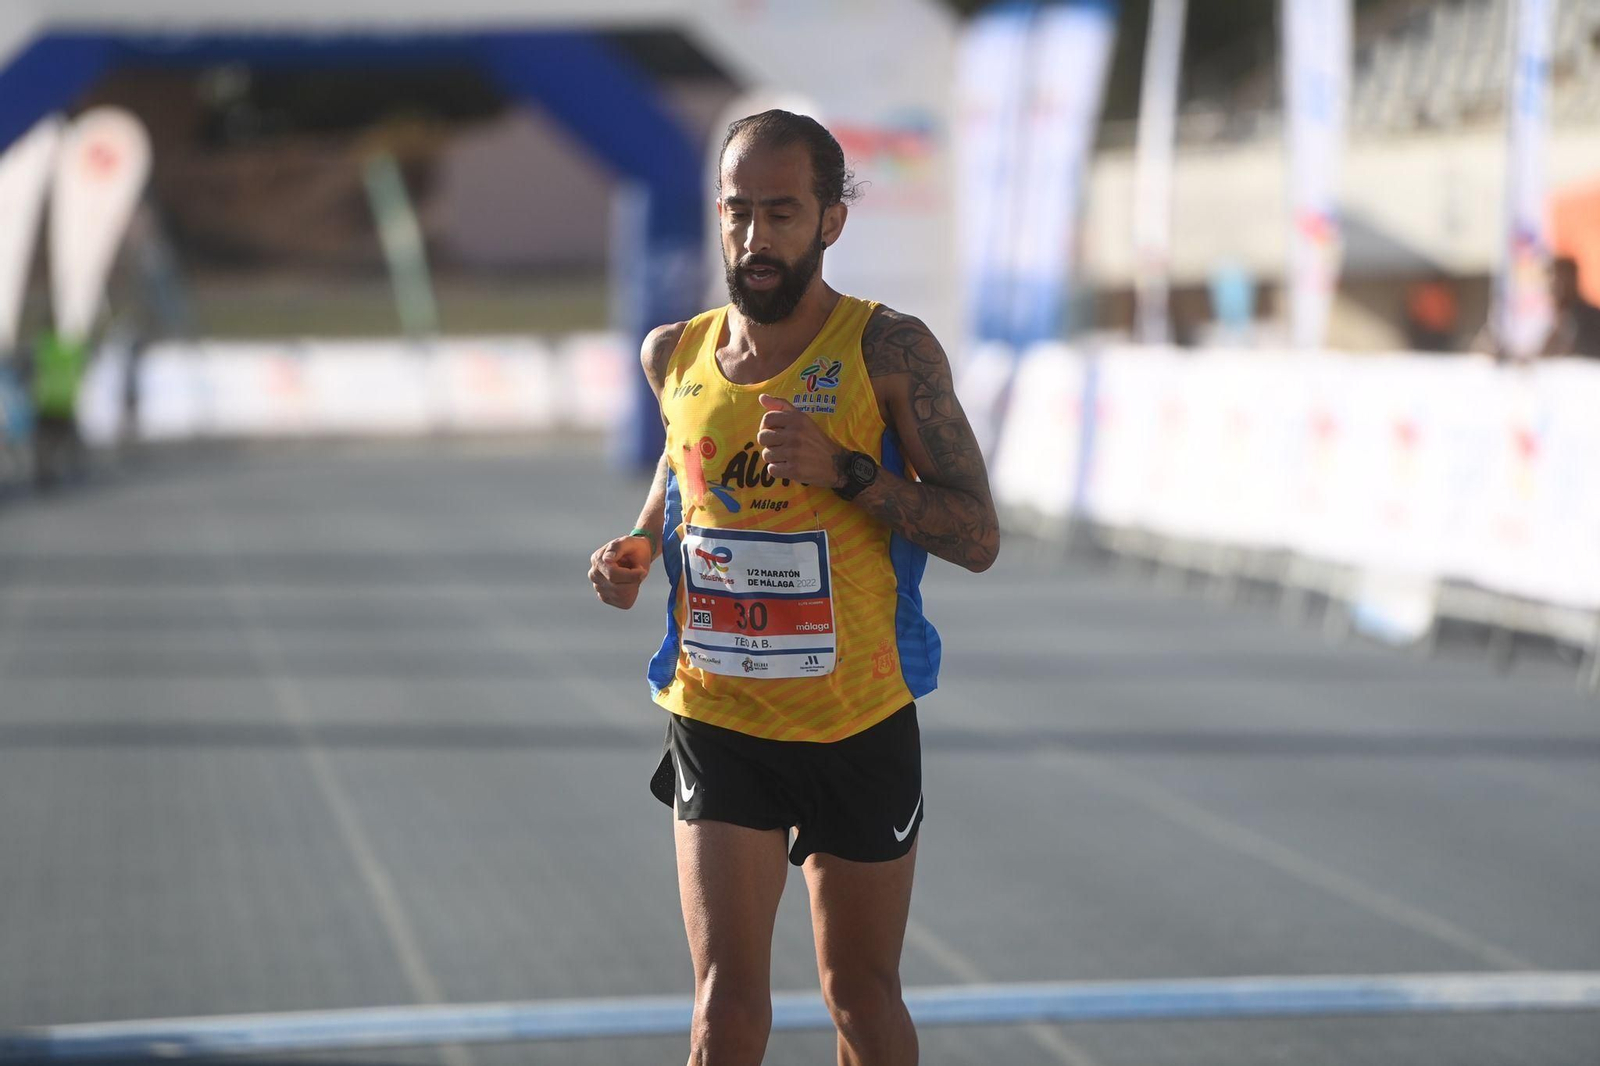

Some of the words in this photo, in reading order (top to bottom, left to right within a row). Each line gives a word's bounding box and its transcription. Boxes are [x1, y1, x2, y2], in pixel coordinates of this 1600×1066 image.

[750, 498, 789, 512] Málaga
[746, 568, 760, 577] 1/2
[760, 569, 801, 578] MARATÓN
[747, 578, 759, 587] DE
[759, 578, 795, 588] MÁLAGA
[796, 578, 817, 588] 2022
[733, 601, 768, 631] 30
[796, 621, 830, 633] málaga
[751, 640, 760, 649] A
[761, 639, 773, 649] B.
